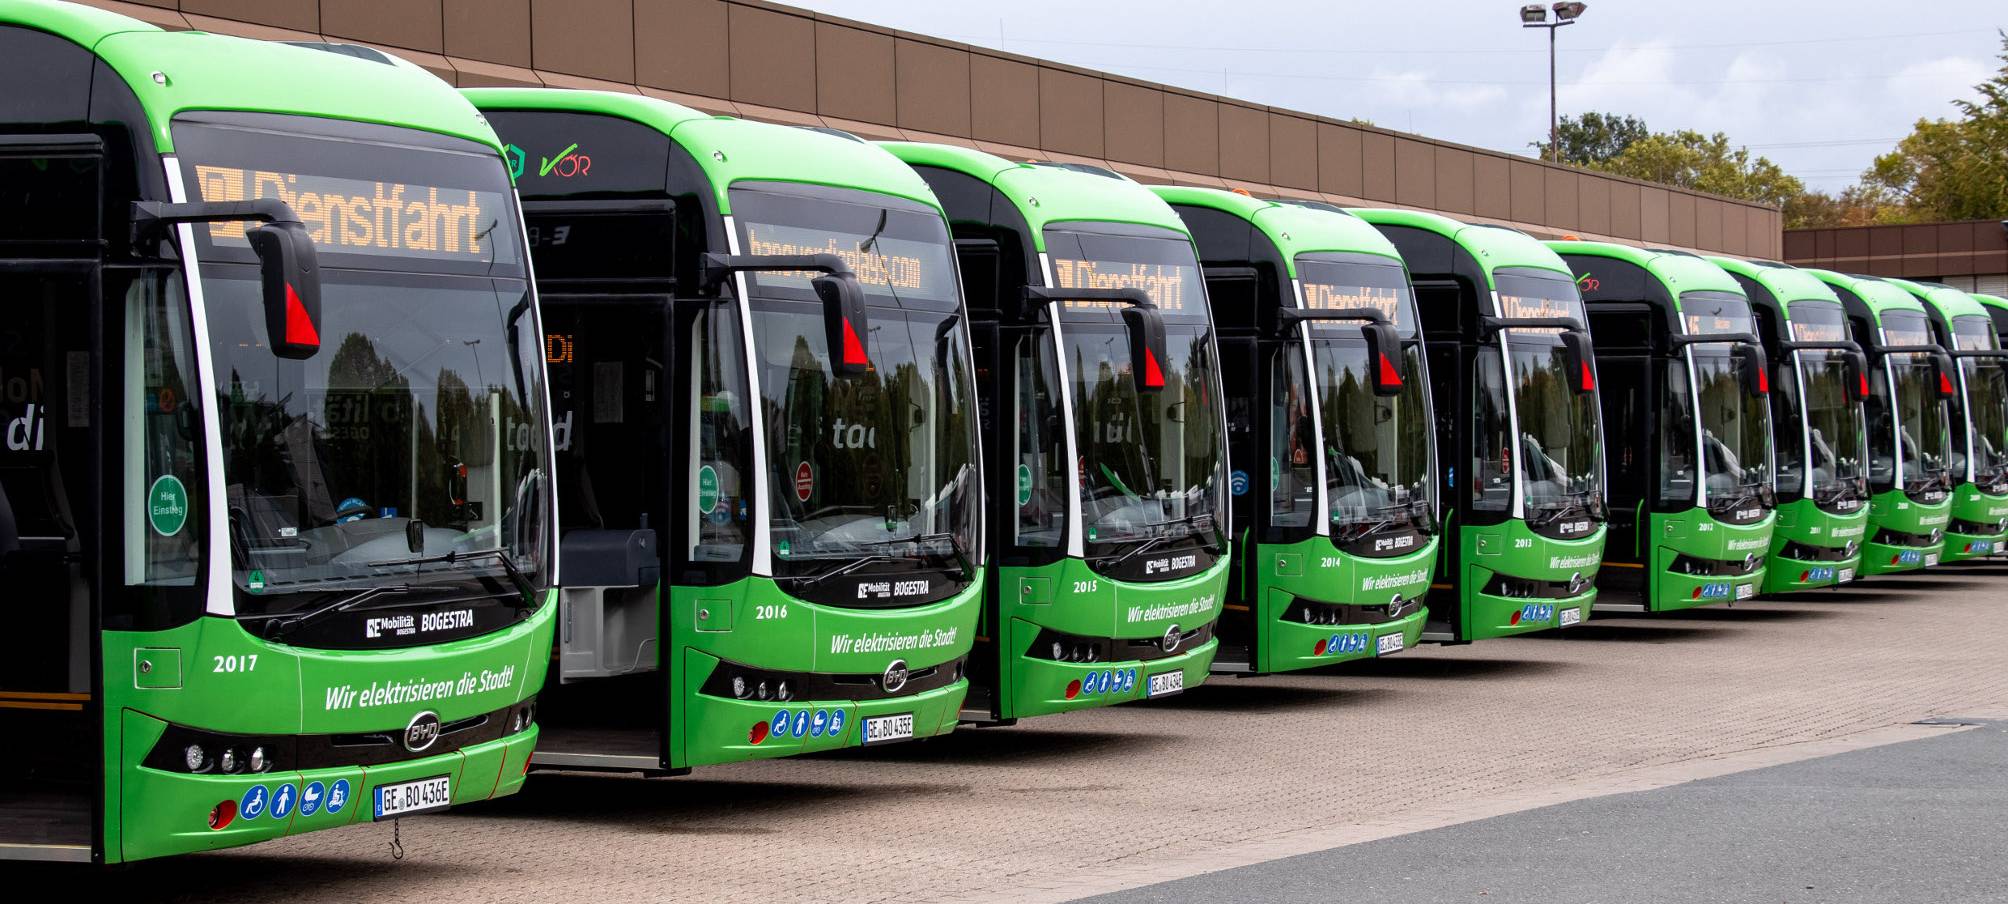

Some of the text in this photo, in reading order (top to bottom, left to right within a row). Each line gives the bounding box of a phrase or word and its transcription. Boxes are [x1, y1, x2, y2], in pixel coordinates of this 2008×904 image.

[254, 170, 481, 254] Dienstfahrt
[547, 334, 573, 363] Di
[160, 491, 176, 501] Hier
[1515, 538, 1532, 548] 2013
[1321, 557, 1341, 568] 2014
[894, 580, 929, 596] BOGESTRA
[1073, 580, 1097, 593] 2015
[381, 615, 415, 630] Mobilität
[421, 609, 473, 632] BOGESTRA
[756, 604, 787, 620] 2016
[1127, 606, 1142, 623] Wir
[1144, 602, 1189, 621] elektrisieren
[831, 626, 957, 654] Wir elektrisieren die Stadt!
[213, 655, 258, 673] 2017
[886, 669, 907, 685] BYD
[1152, 677, 1160, 694] GE
[325, 664, 514, 710] Wir elektrisieren die Stadt!
[409, 722, 438, 742] BYD
[868, 716, 912, 739] GE BO 435E
[383, 788, 398, 812] GE
[406, 784, 420, 808] BO
[422, 780, 448, 805] 436E
